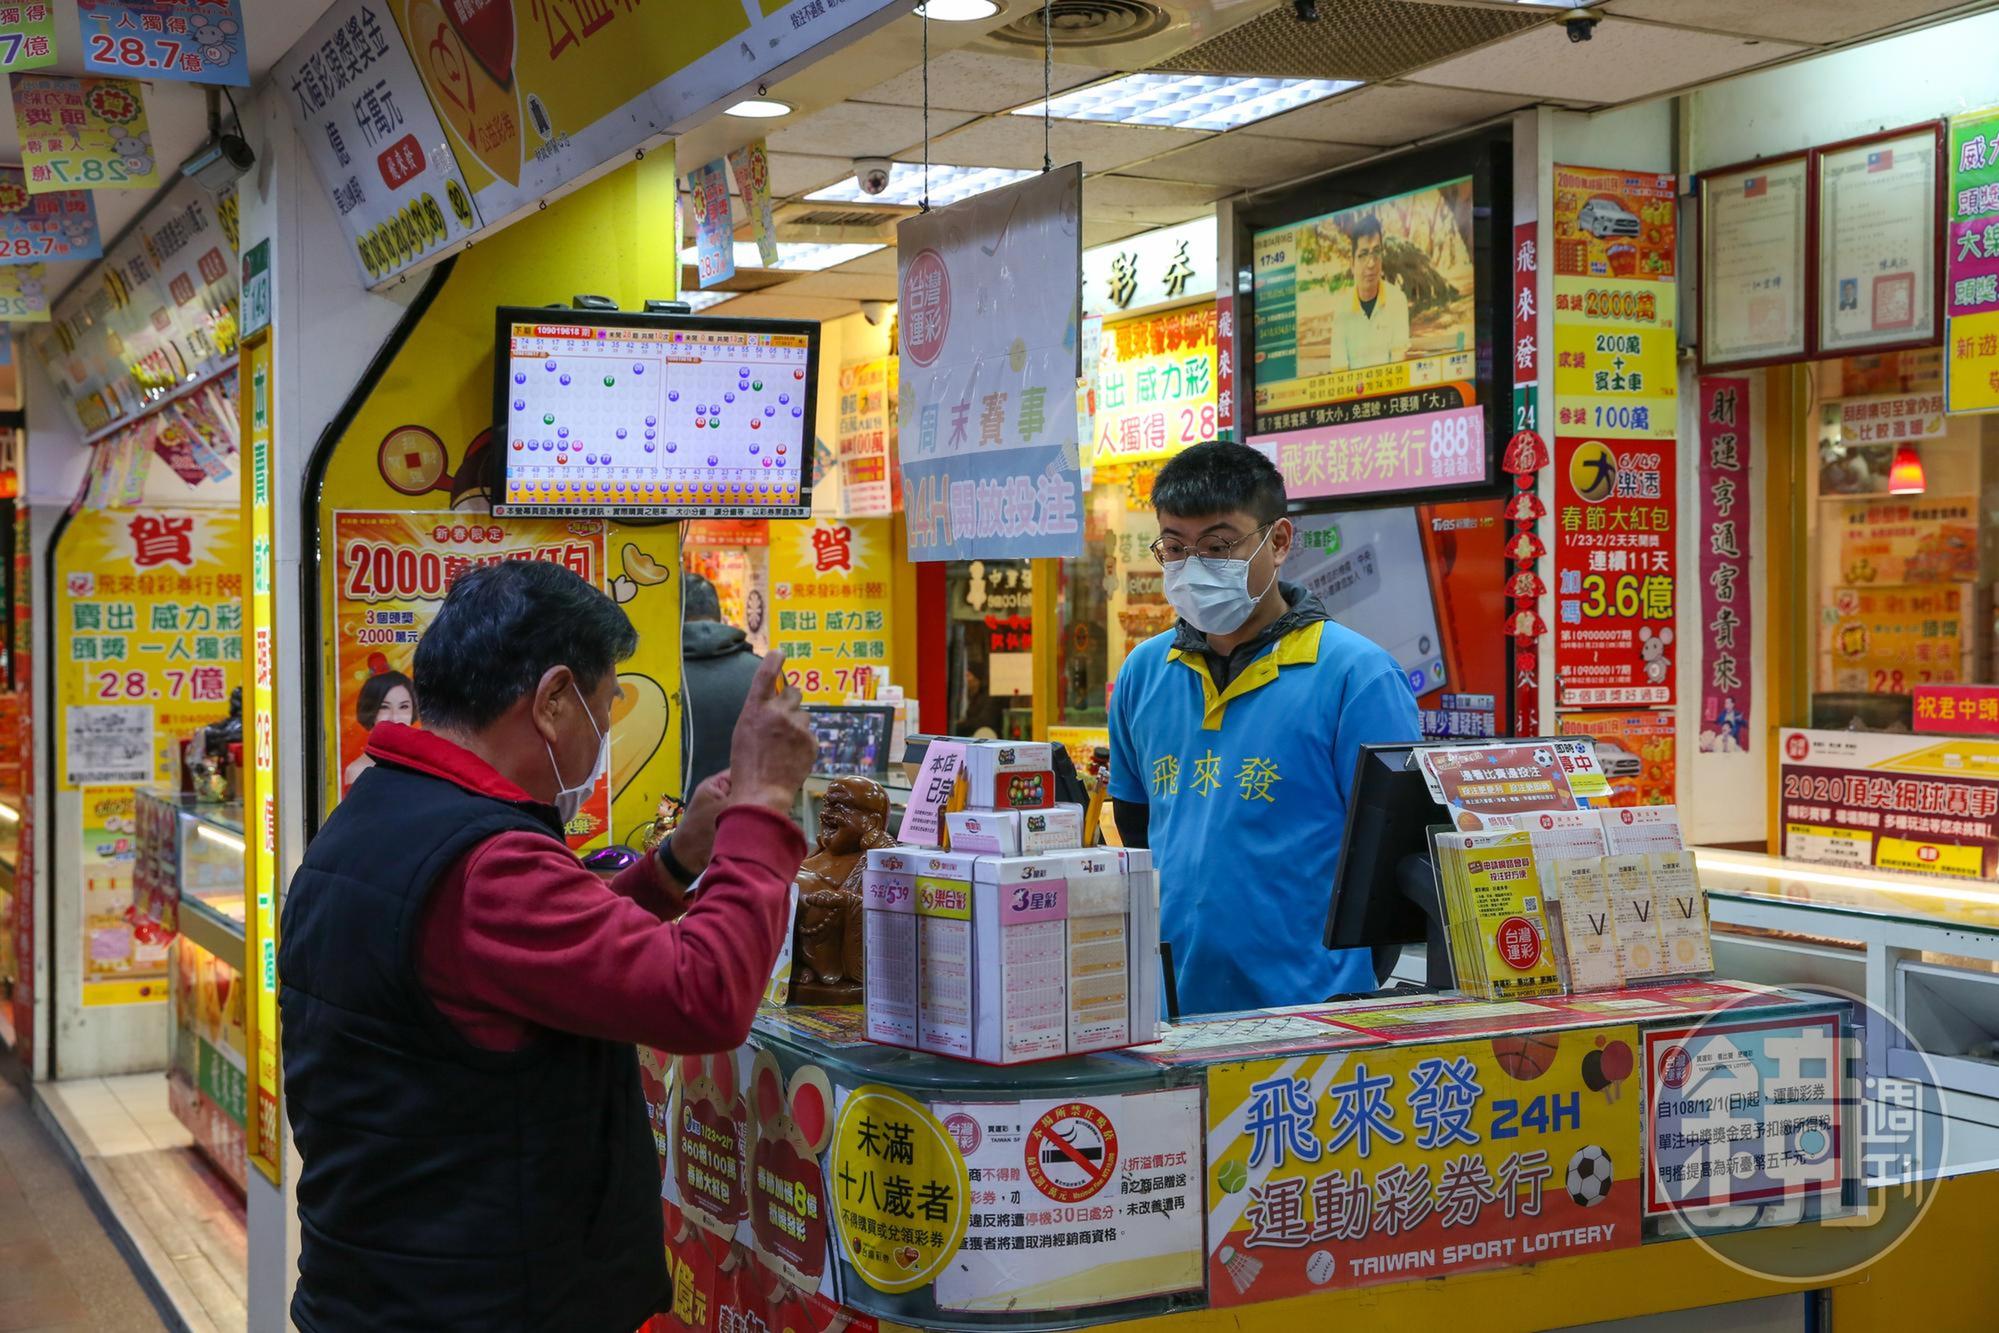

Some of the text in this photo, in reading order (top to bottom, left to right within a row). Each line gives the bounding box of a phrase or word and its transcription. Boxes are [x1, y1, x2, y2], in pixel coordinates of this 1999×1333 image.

[90, 13, 188, 33] 一人獨得
[92, 34, 203, 72] 28.7億
[1260, 250, 1286, 266] 17:49
[1516, 239, 1537, 371] 飛來發
[1585, 289, 1657, 322] 2000萬
[1596, 334, 1641, 355] 200萬
[1595, 372, 1643, 392] 賓士車
[1594, 406, 1650, 431] 100萬
[1281, 416, 1469, 488] 飛來發彩券行 888
[1619, 453, 1661, 469] 6/49
[434, 525, 504, 543] 新春限定
[1561, 506, 1671, 532] 春節大紅包
[127, 513, 194, 567] 賀
[812, 526, 852, 572] 賀
[1588, 551, 1669, 572] 連續11天
[1581, 574, 1674, 621] 3.6億
[72, 603, 242, 631] 賣出 威力彩
[780, 611, 882, 631] 賣出 威力彩
[98, 666, 226, 701] 28.7億
[929, 754, 958, 773] 本店
[1152, 749, 1283, 803] 飛來發
[1784, 773, 1999, 817] 2020頂尖網球賽事
[870, 883, 910, 905] 今彩539
[1012, 887, 1058, 912] 3星彩
[1505, 927, 1532, 945] 台灣
[1507, 943, 1535, 961] 運彩
[1244, 1056, 1581, 1168] 飛來發 24H
[857, 1115, 914, 1166] 未滿
[838, 1160, 954, 1224] 十八歲者
[1243, 1150, 1552, 1247] 運動彩券行
[842, 1207, 945, 1248] 不得購買或兌領彩券
[1349, 1222, 1617, 1278] TAIWAN SPORT LOTTERY
